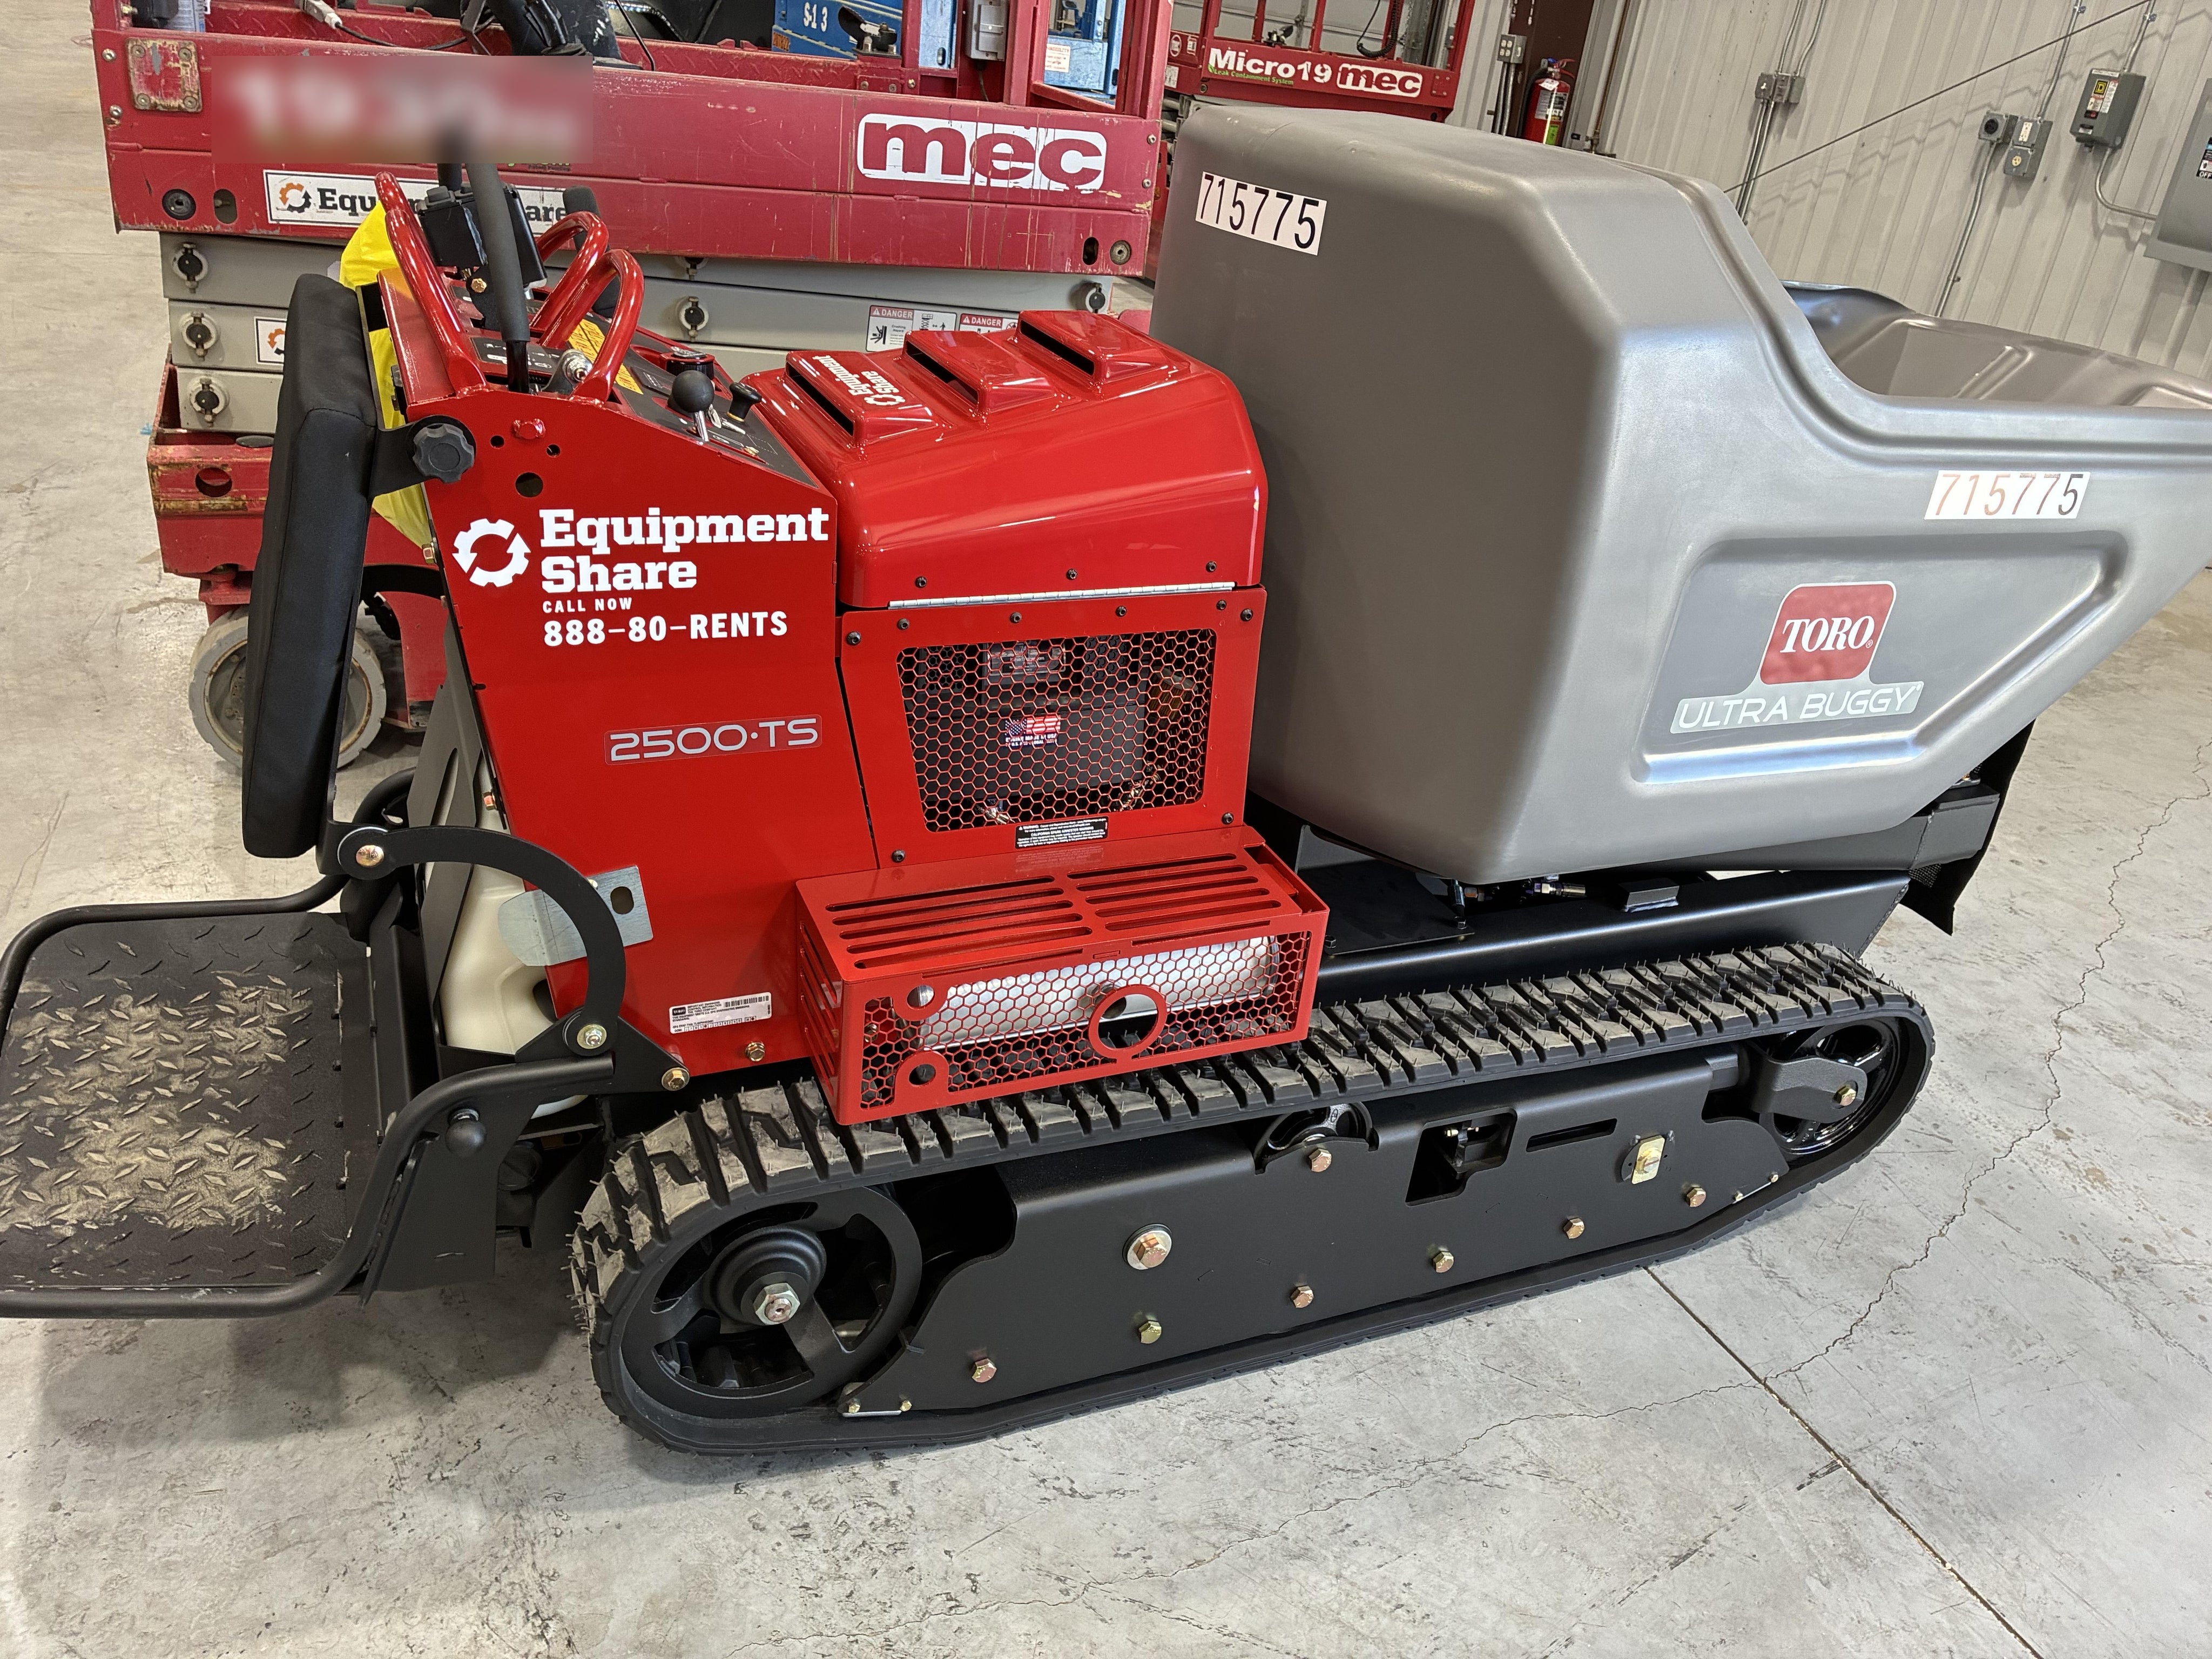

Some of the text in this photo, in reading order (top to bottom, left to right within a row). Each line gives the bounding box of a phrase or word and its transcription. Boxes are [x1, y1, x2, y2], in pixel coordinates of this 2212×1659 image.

[1272, 76, 1294, 86] System
[1338, 64, 1421, 95] mec
[863, 120, 1103, 187] mec
[1199, 173, 1319, 249] 715775
[881, 309, 913, 319] DANGER
[972, 317, 1002, 327] DANGER
[812, 355, 874, 396] Equipment
[861, 370, 900, 393] Share
[1936, 473, 2084, 516] 715775
[539, 507, 829, 555] Equipment
[541, 555, 697, 593] Share
[542, 597, 632, 613] CALL NOW
[544, 611, 787, 647] 888-80-RENTS
[1679, 697, 1789, 729] ULTRA
